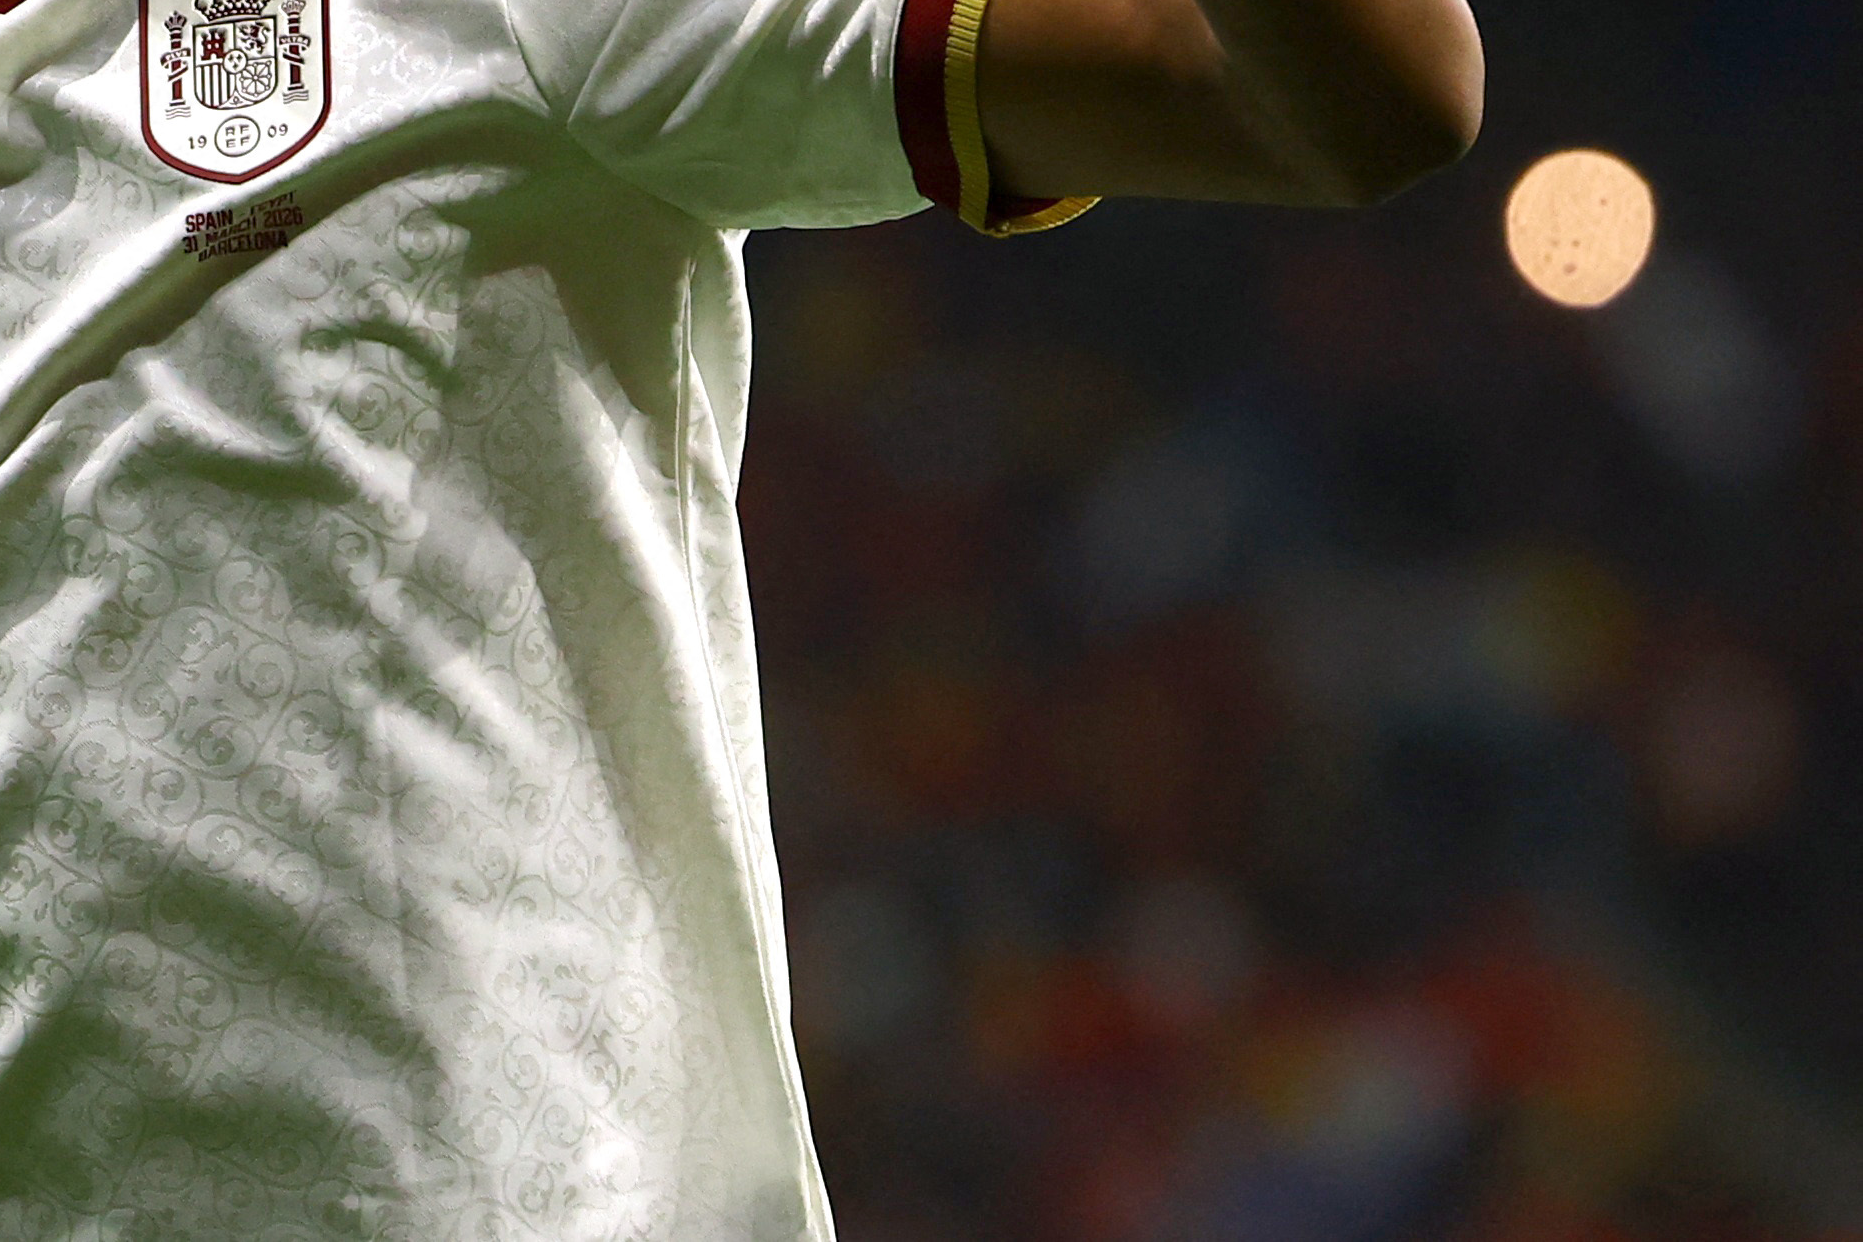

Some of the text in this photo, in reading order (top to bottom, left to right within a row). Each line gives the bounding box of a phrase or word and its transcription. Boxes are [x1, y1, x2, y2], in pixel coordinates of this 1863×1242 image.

[267, 123, 288, 138] 09
[188, 134, 207, 150] 19
[182, 235, 198, 253] 31
[264, 207, 303, 228] 2026
[185, 209, 233, 233] SPAIN
